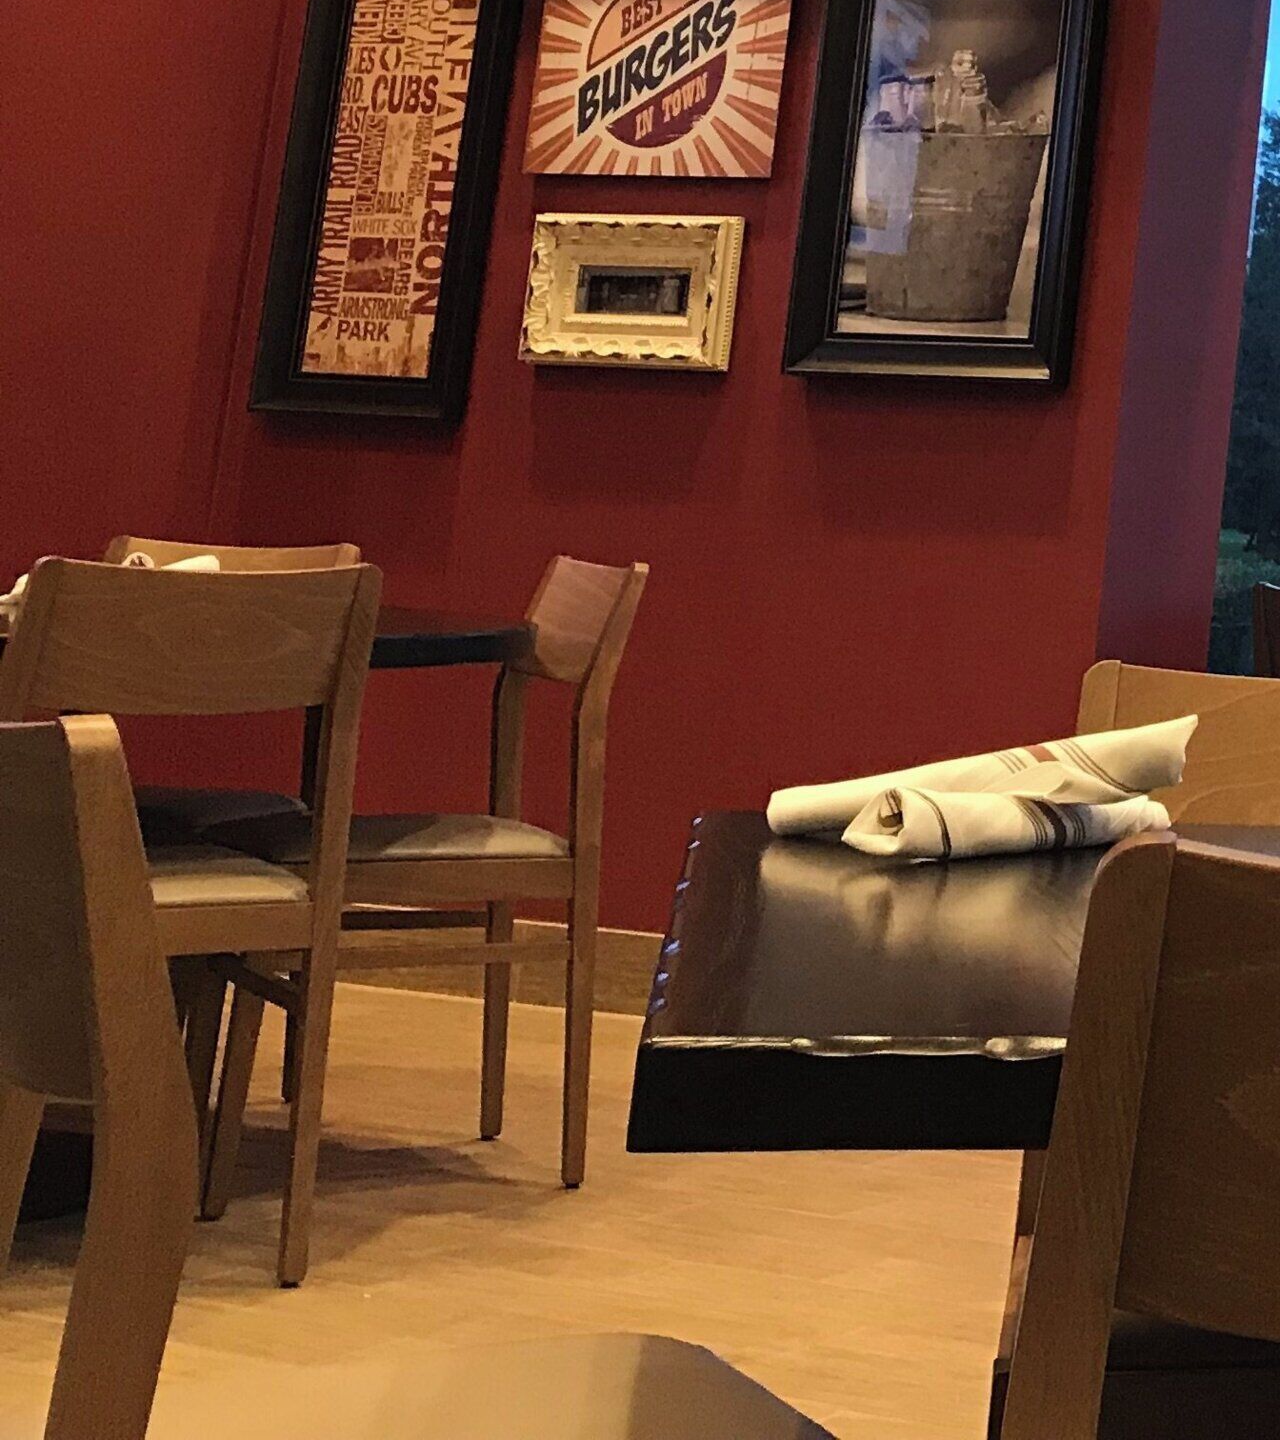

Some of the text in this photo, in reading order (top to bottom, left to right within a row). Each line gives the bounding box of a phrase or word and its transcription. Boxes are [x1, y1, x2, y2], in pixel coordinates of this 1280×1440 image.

[402, 36, 425, 73] AVE
[371, 74, 439, 114] CUBS
[634, 72, 709, 142] IN TOWN
[353, 115, 388, 216] BLACKHAWKS
[312, 134, 363, 318] ARMY TRAIL ROAD
[352, 218, 389, 235] WHITE
[409, 157, 458, 316] NORTH
[394, 237, 416, 296] BEARS
[336, 320, 391, 342] PARK
[338, 297, 410, 320] ARMSTRONG
